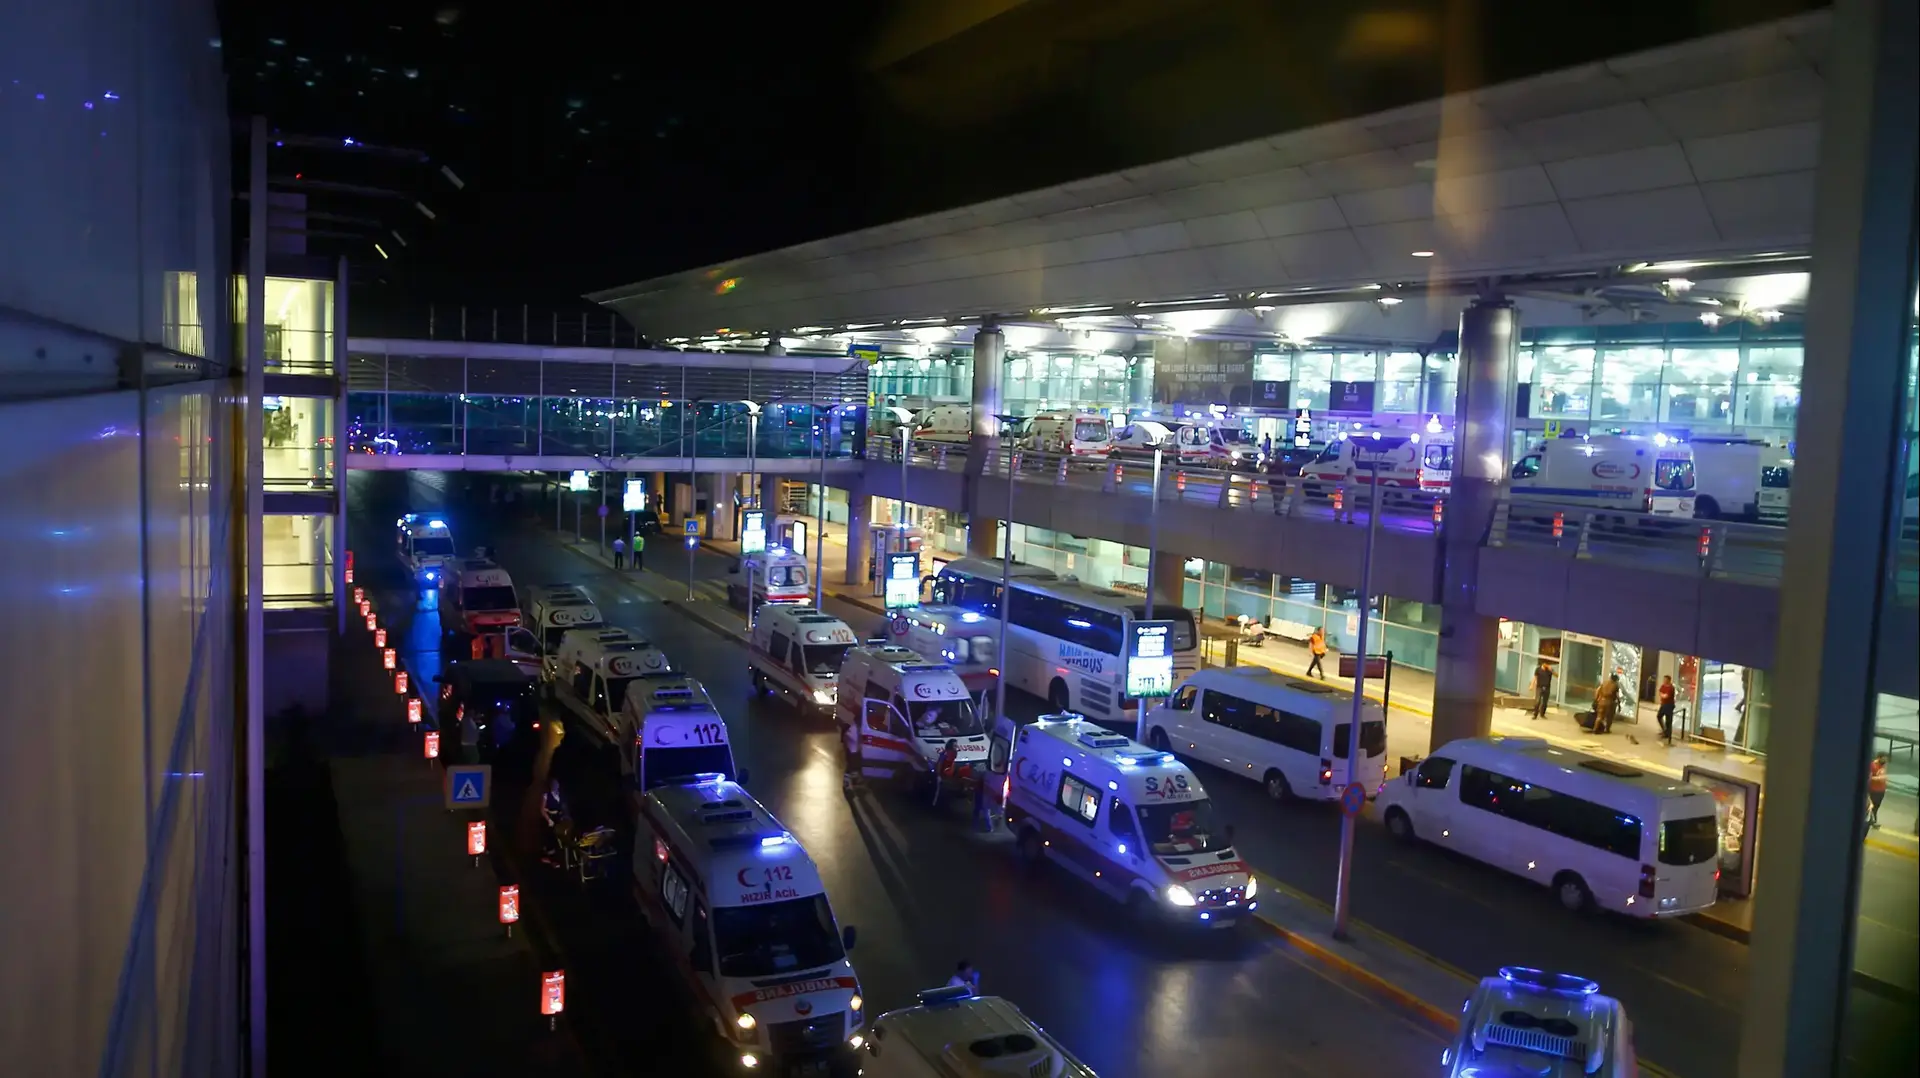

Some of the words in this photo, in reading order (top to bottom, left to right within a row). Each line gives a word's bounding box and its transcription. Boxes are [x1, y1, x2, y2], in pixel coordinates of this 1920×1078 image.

[832, 628, 852, 642] 112
[615, 661, 632, 669] 112
[694, 723, 724, 744] 112
[1145, 774, 1188, 797] SAS
[764, 865, 793, 882] 112
